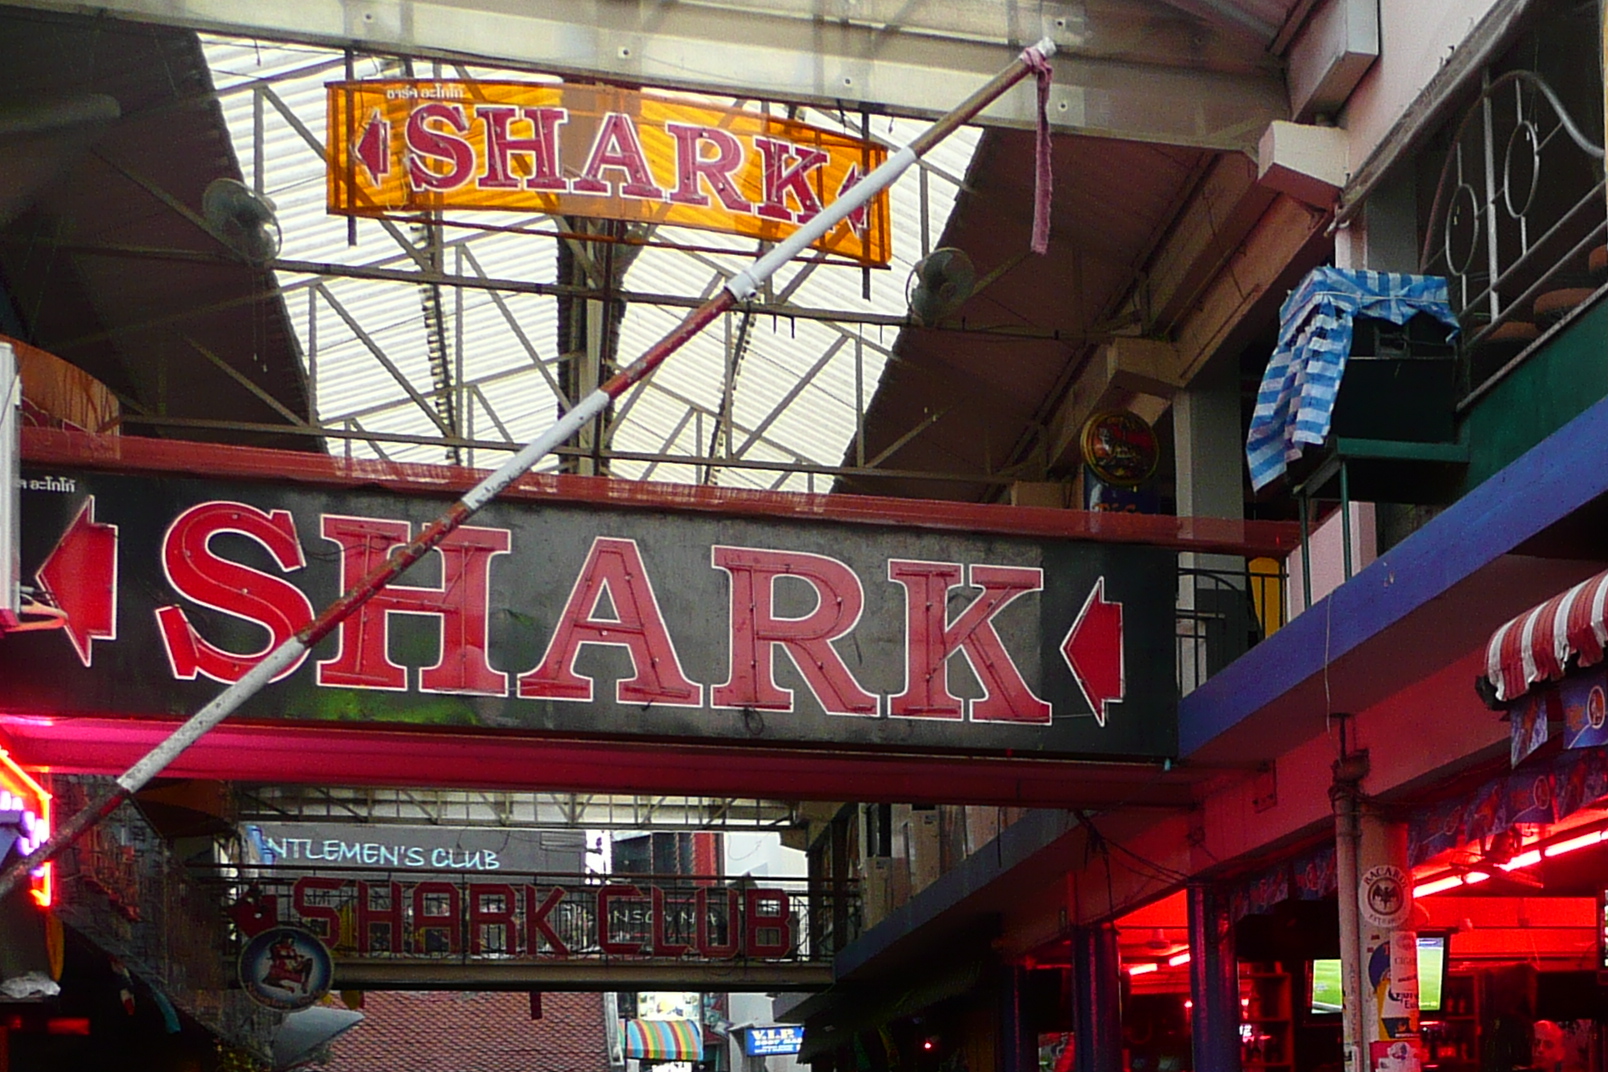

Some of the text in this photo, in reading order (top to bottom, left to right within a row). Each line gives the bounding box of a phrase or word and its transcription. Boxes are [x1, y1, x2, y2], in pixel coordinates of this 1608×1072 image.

[404, 103, 832, 225] SHARK
[154, 499, 1058, 732] SHARK
[266, 836, 501, 871] NTLEMEN'S CLUB
[1364, 867, 1408, 890] BACARDI
[292, 875, 793, 961] SHARK CLUB
